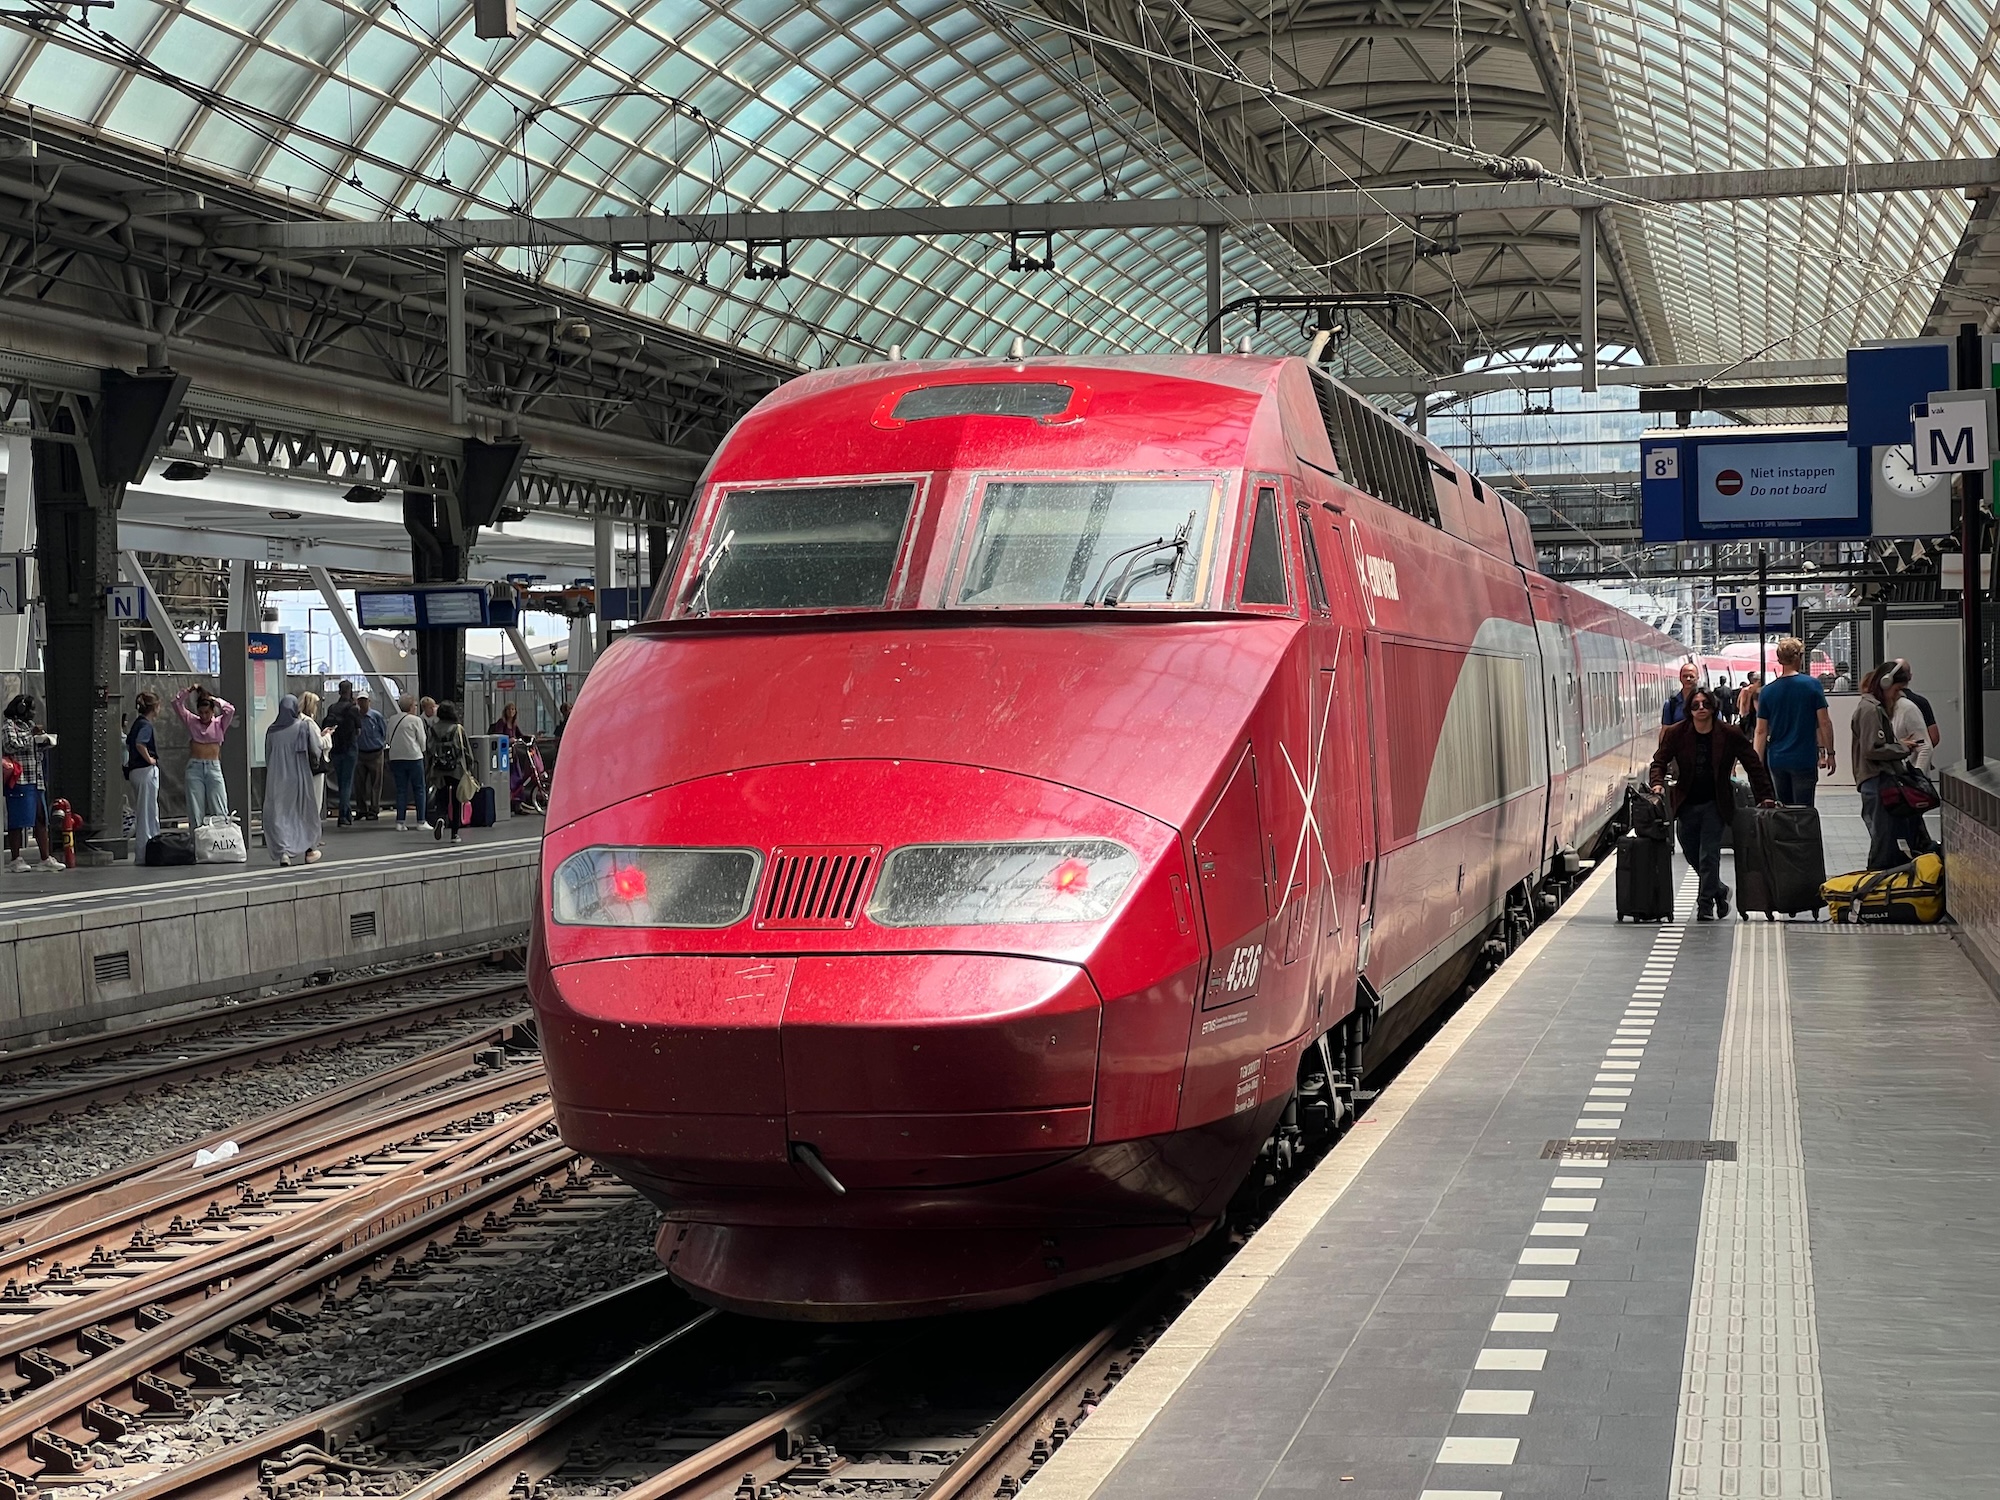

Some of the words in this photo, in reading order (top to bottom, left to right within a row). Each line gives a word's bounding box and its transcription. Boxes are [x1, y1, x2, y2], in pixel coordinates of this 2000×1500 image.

[1930, 427, 1974, 465] M
[1750, 467, 1774, 479] Niet
[1778, 466, 1835, 480] instappen
[1750, 485, 1766, 496] Do
[1769, 485, 1789, 496] not
[1792, 483, 1827, 495] board
[115, 596, 131, 616] N
[1741, 595, 1752, 607] O
[212, 839, 236, 850] ALIX
[1226, 944, 1262, 991] 4536
